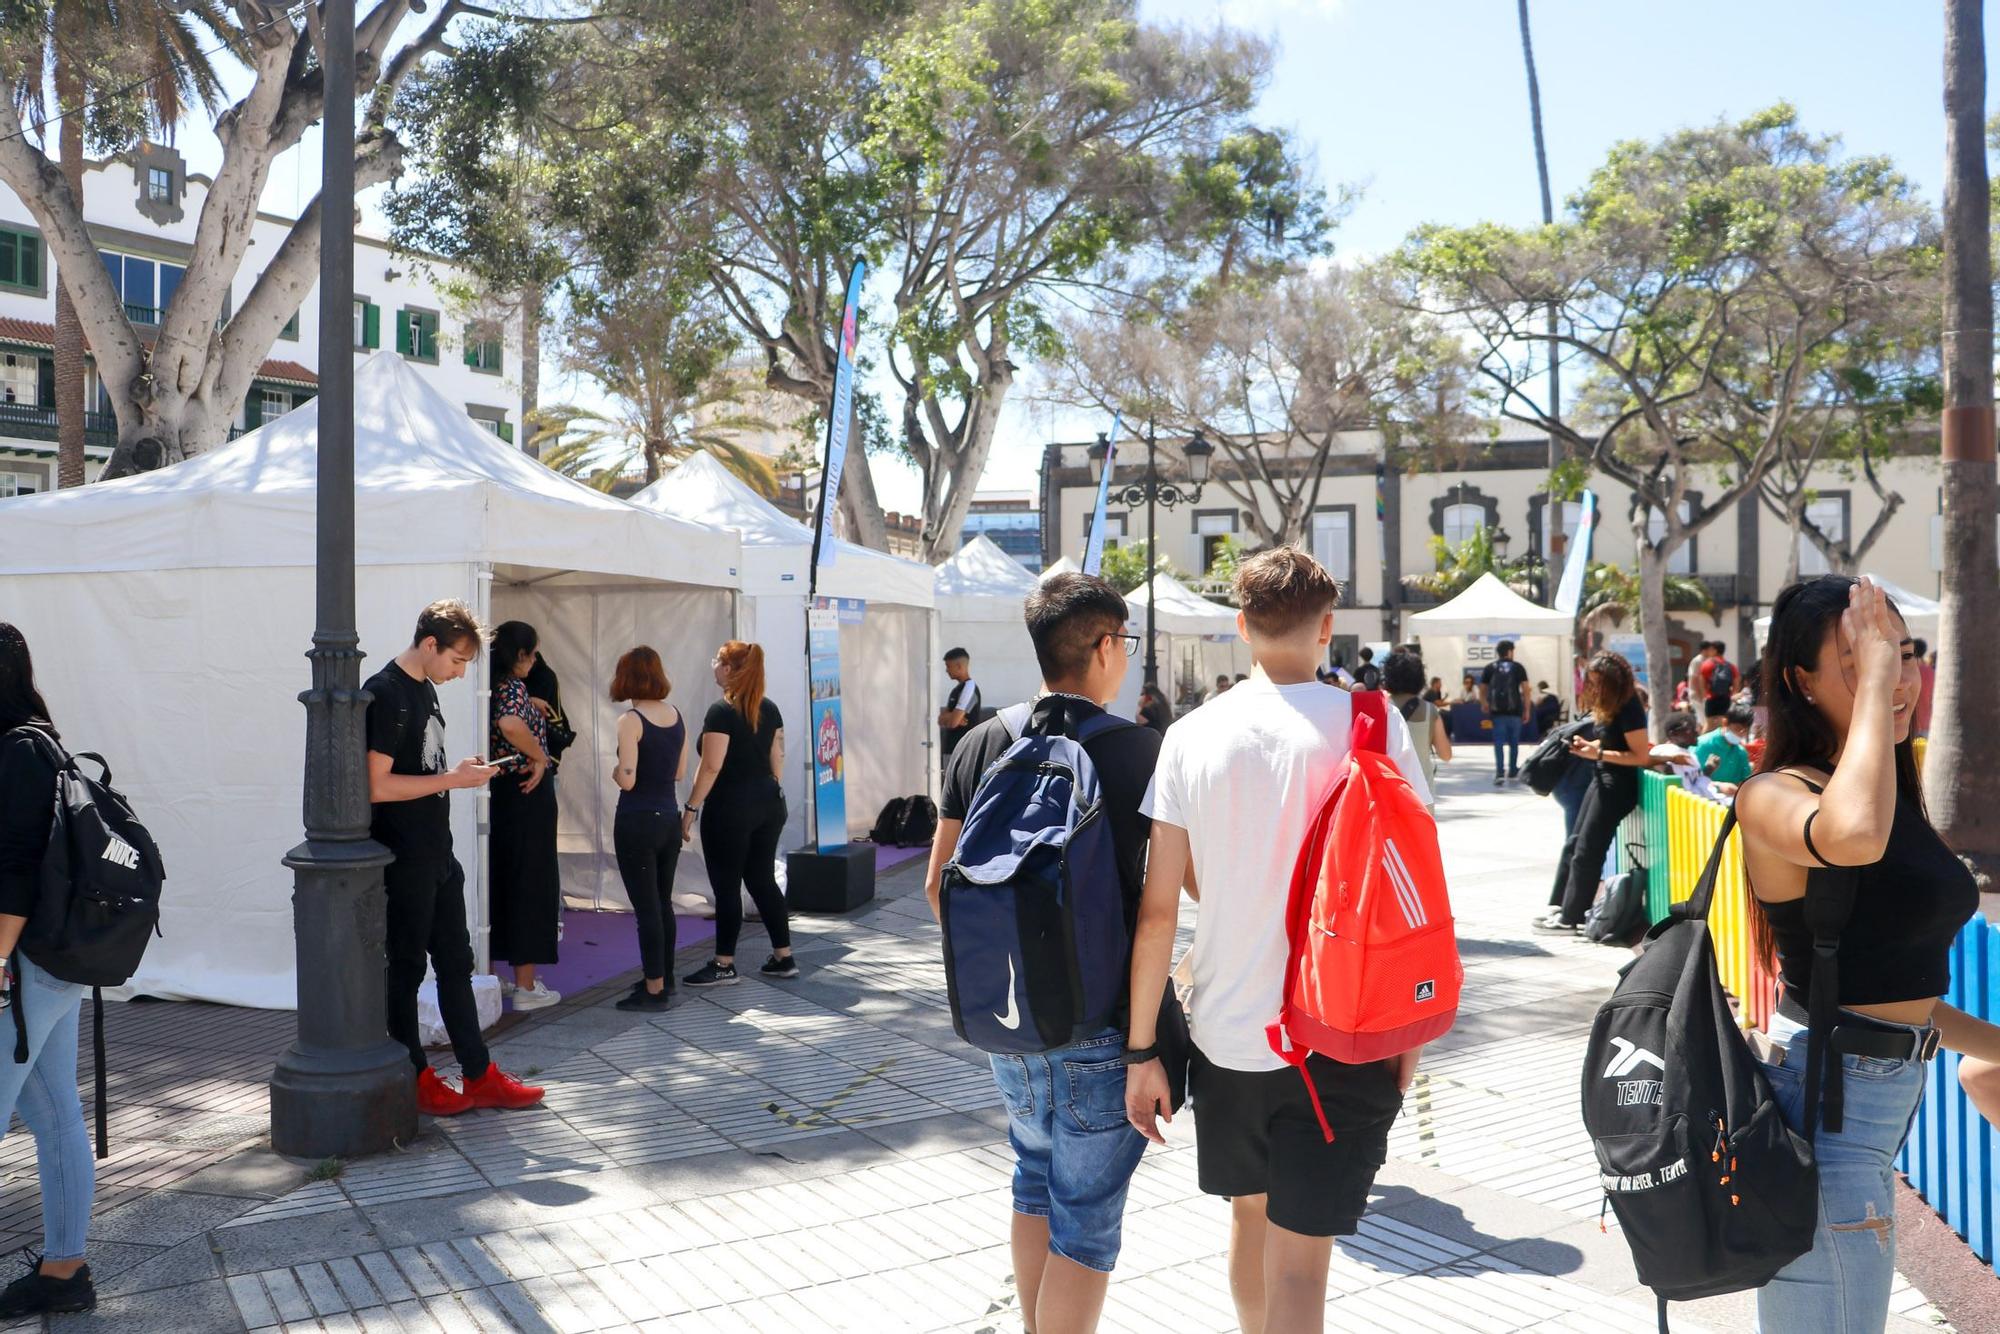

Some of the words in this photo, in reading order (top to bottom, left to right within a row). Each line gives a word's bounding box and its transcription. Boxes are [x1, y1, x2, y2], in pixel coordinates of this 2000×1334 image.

[1467, 647, 1498, 660] SE
[101, 837, 140, 870] NIKE
[1617, 1080, 1663, 1105] TENTH
